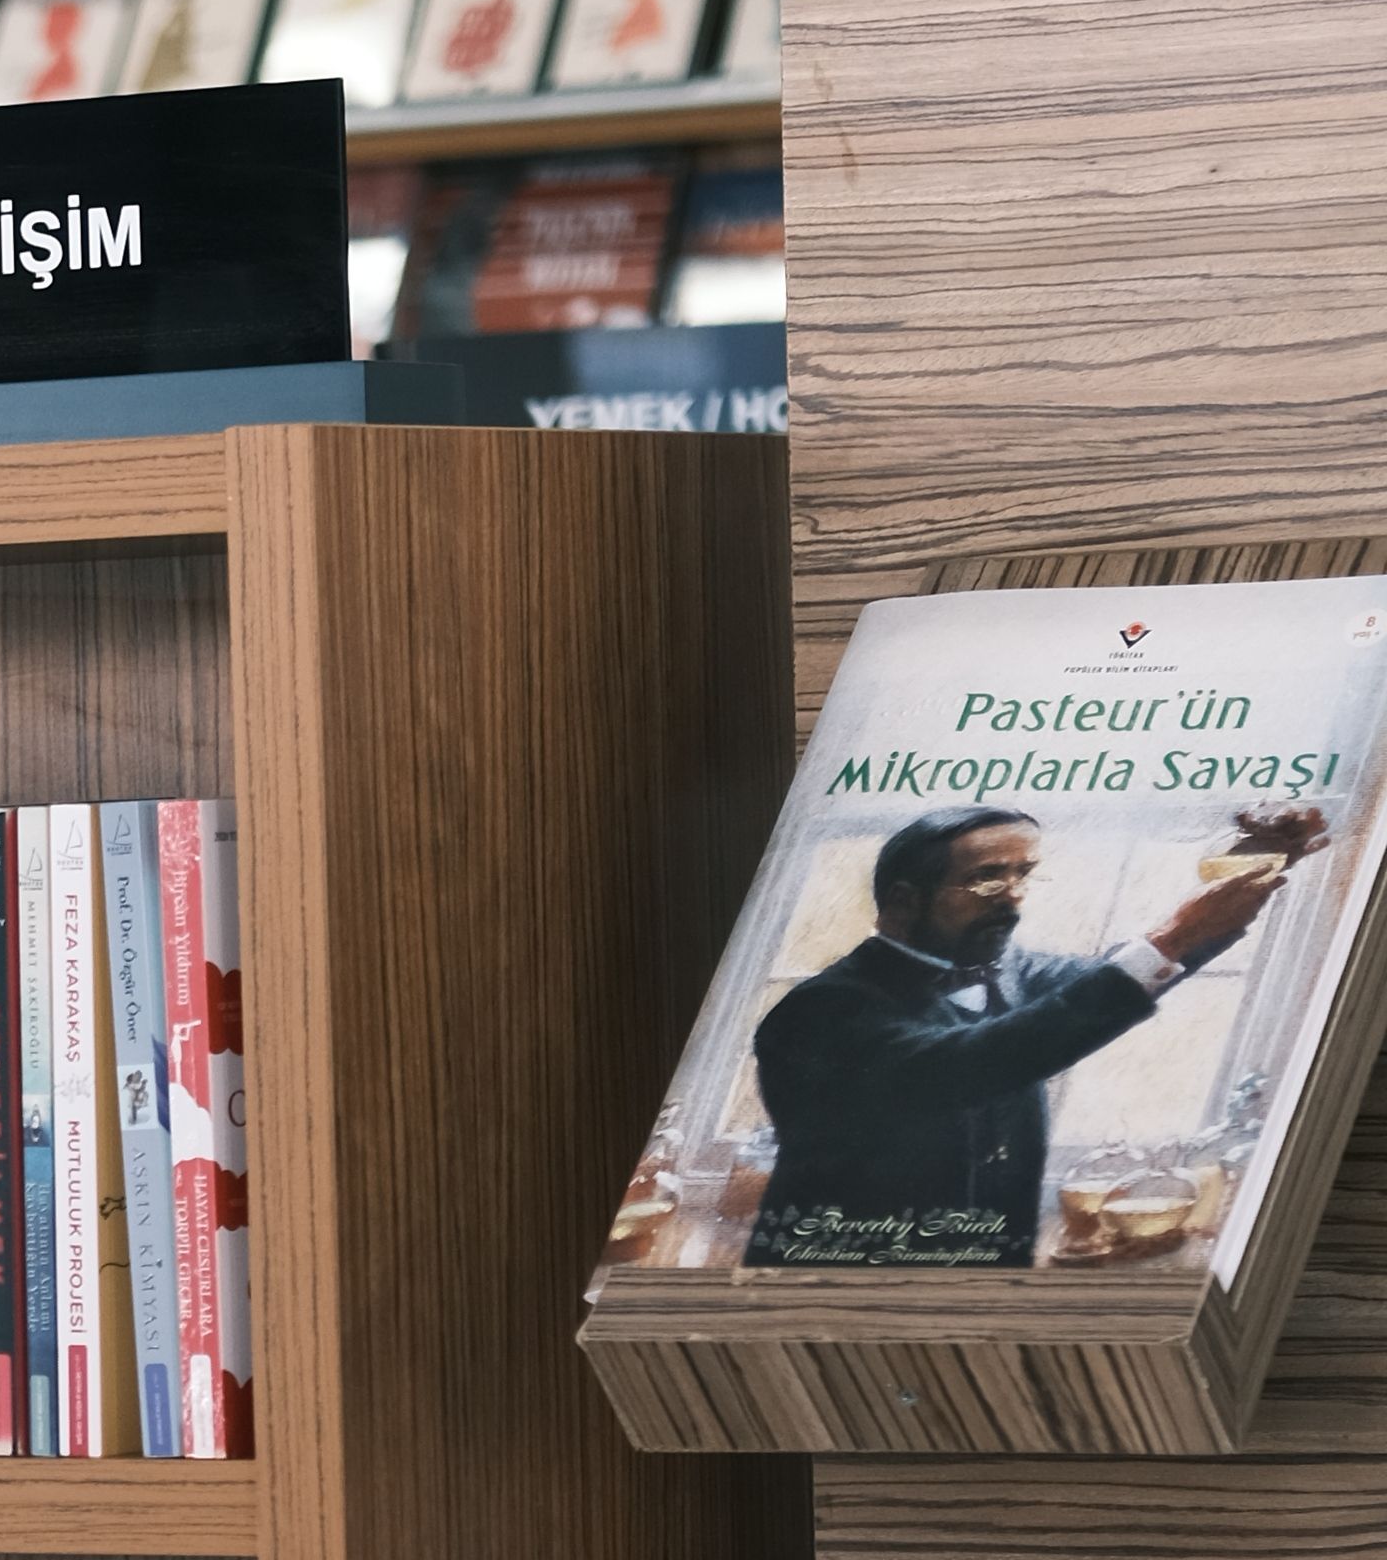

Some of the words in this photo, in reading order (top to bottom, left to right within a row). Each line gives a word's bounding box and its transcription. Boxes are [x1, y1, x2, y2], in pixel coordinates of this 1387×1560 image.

[1366, 616, 1375, 627] 8
[955, 689, 1251, 733] Pasteur'ün
[826, 750, 1135, 802] Mikroplarla
[1153, 750, 1339, 800] Savaşı
[63, 894, 81, 955] FEZA
[63, 959, 83, 1063] KARAKAŞ
[66, 1121, 85, 1237] MUTLULUK
[794, 1211, 915, 1240] Beverley
[919, 1211, 1006, 1240] Birch
[68, 1243, 87, 1335] PROJESİ
